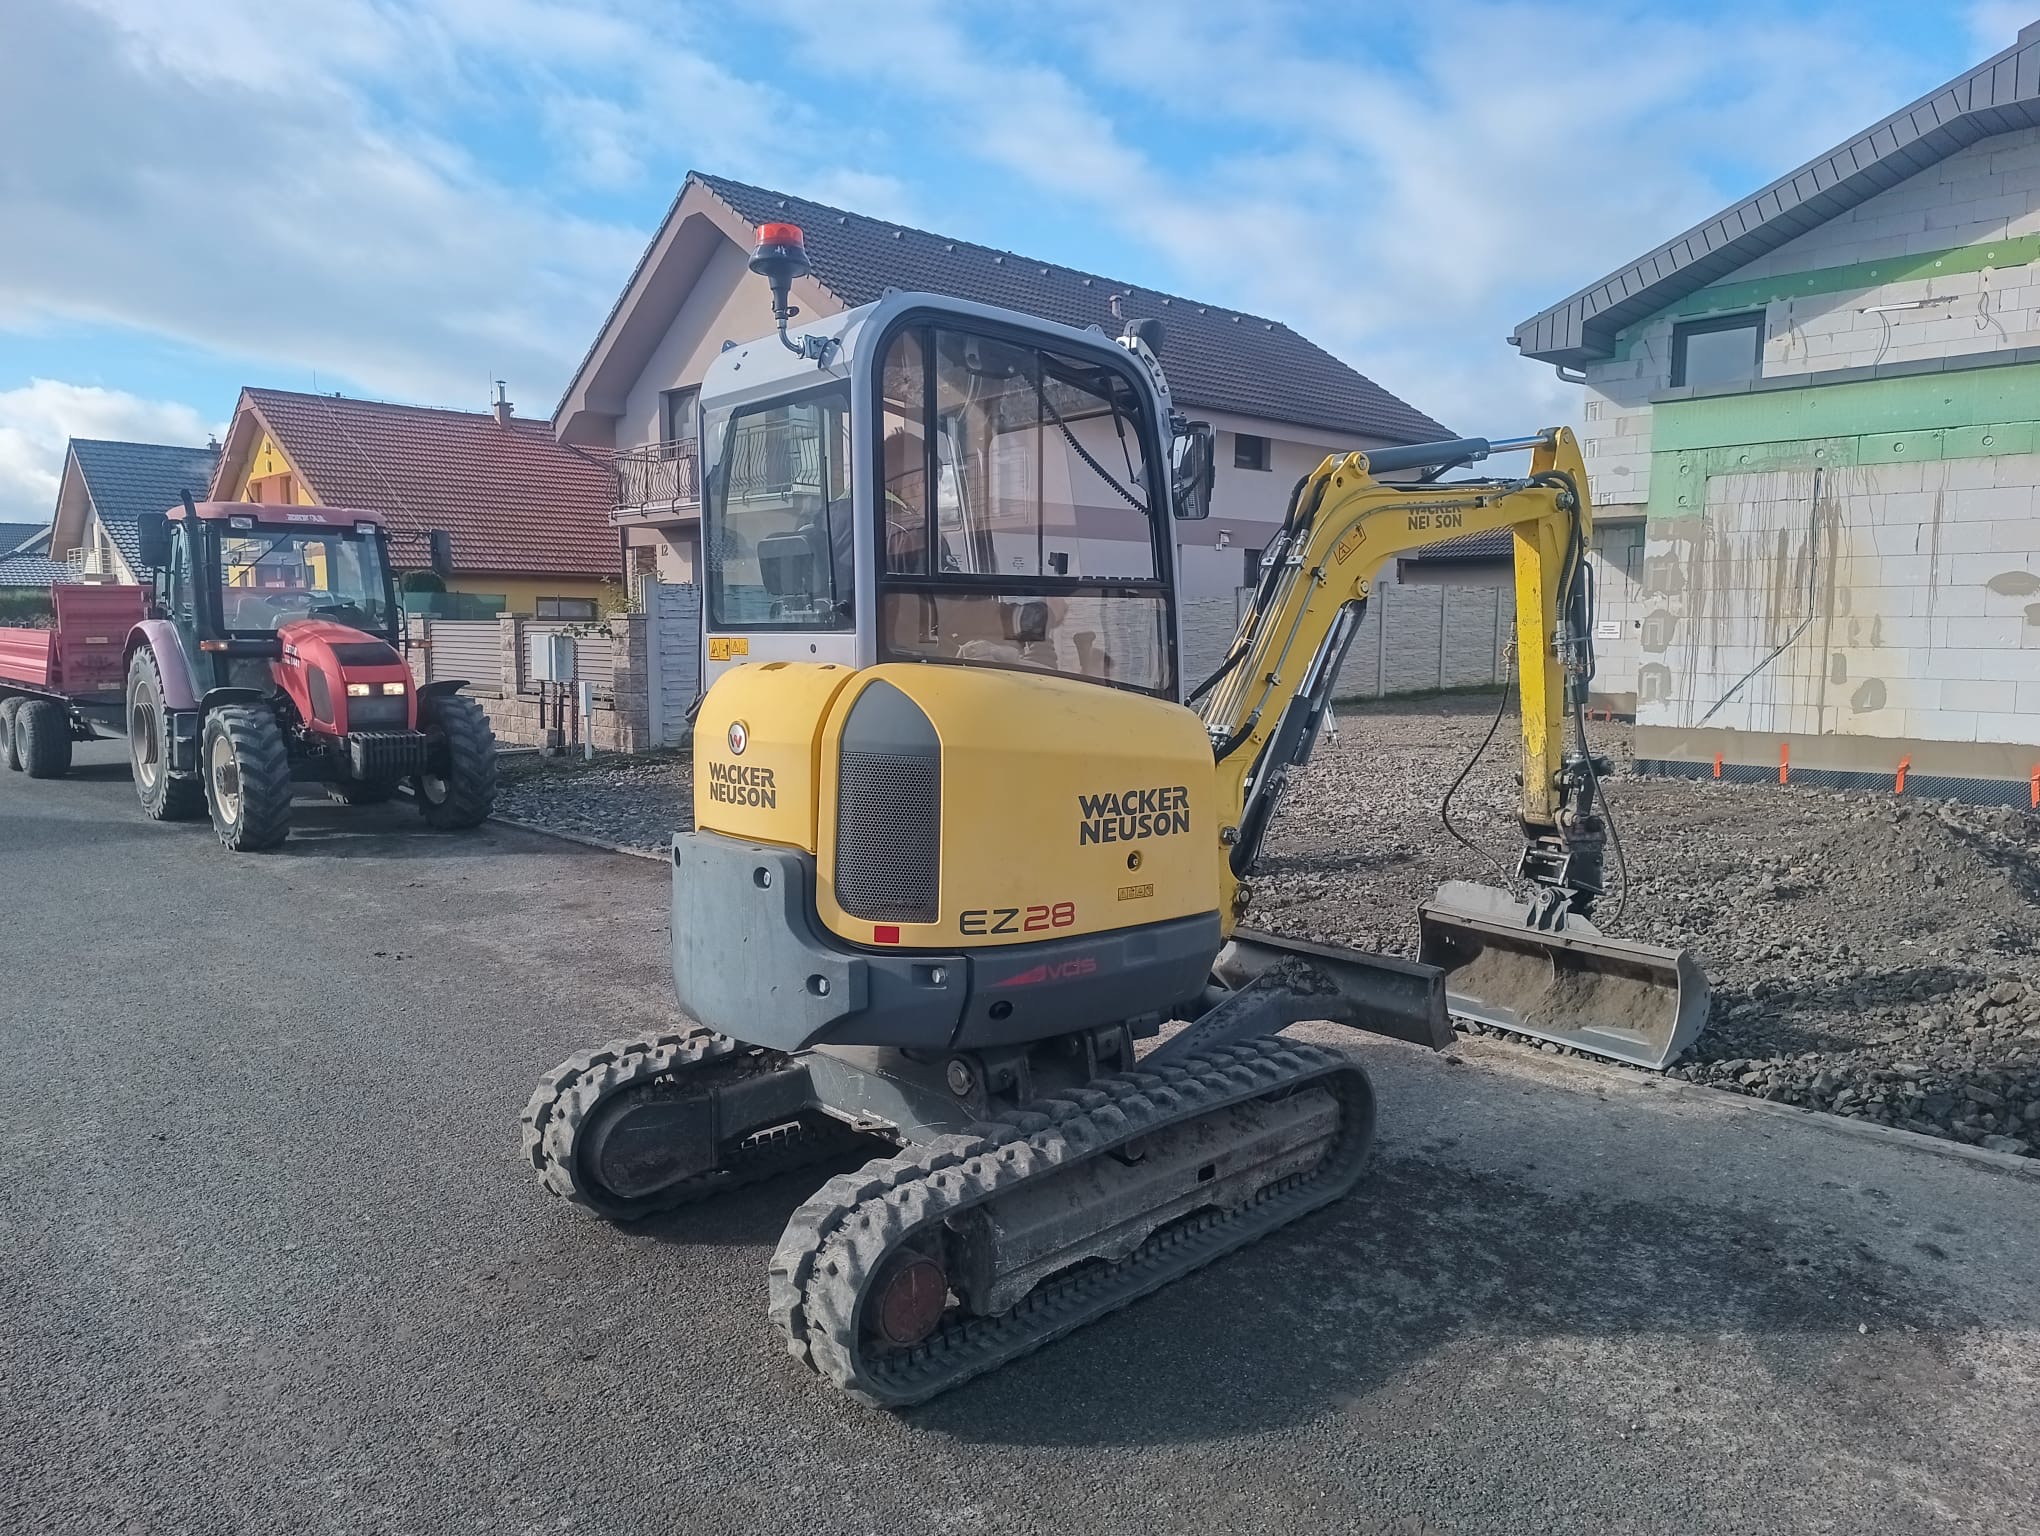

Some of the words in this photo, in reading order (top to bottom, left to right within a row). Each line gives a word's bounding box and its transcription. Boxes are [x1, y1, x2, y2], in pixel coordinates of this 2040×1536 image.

[708, 761, 777, 789] WACKER
[709, 781, 776, 809] NEUSON
[1077, 786, 1190, 819] WACKER
[1079, 809, 1190, 846] NEUSON
[959, 901, 1075, 935] EZ28
